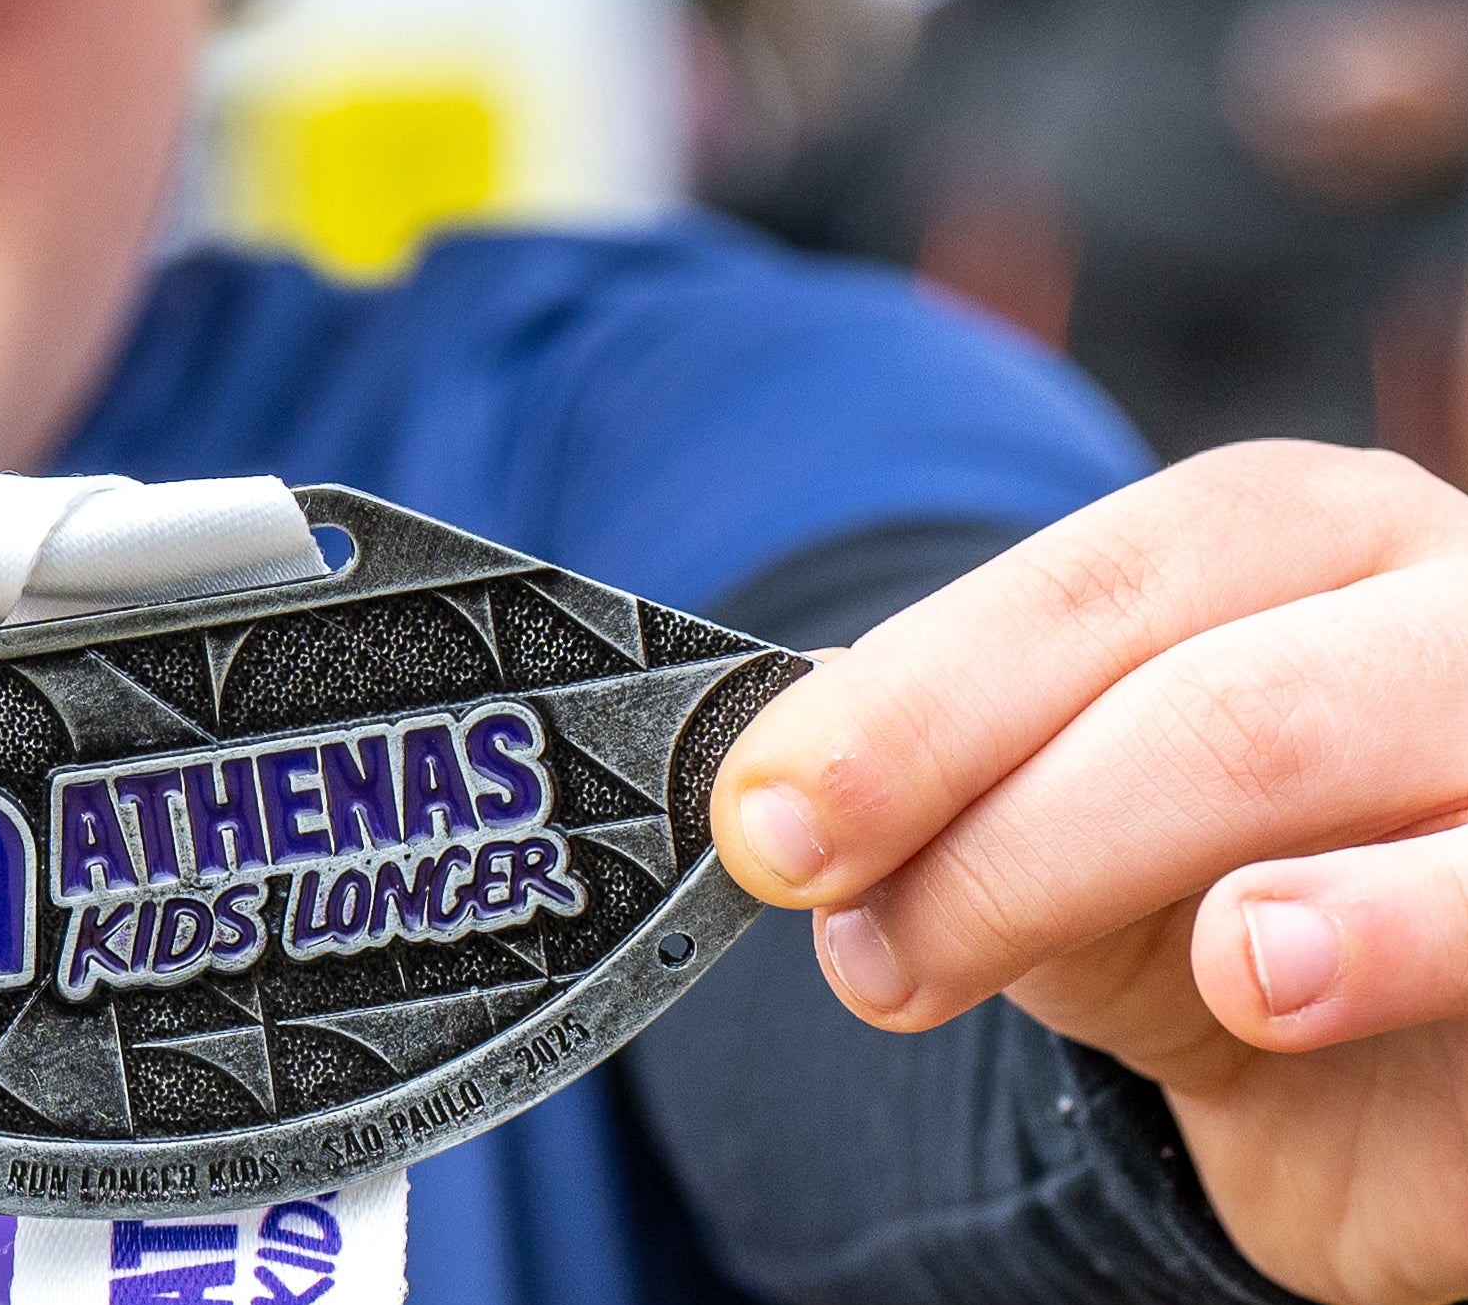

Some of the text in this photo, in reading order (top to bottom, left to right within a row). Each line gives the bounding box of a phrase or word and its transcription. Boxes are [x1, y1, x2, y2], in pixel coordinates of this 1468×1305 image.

[62, 712, 535, 895] ATHENAS
[68, 839, 576, 988] KIDS LONGER
[5, 1157, 68, 1197] RUN
[78, 1162, 202, 1205] LONGER
[208, 1149, 281, 1195] KIDS
[387, 1079, 487, 1152] PAULO
[514, 1012, 591, 1083] 2025
